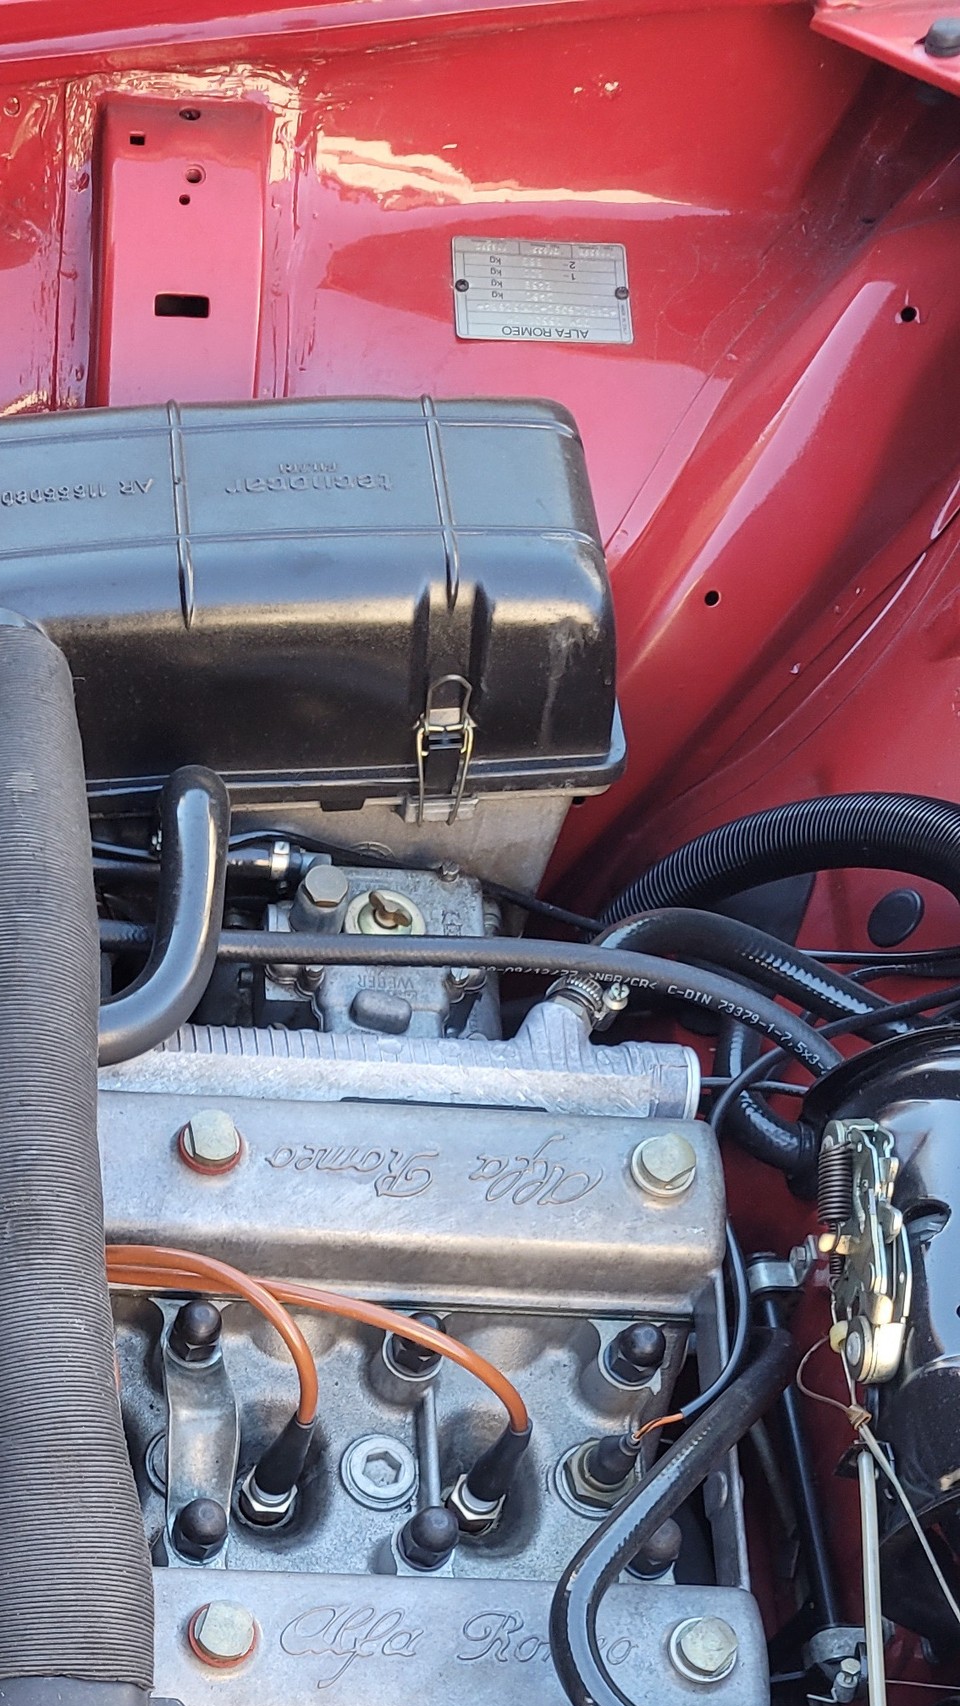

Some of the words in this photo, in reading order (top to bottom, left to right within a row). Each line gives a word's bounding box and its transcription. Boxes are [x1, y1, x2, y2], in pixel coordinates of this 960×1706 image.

[502, 325, 552, 337] ROMEO
[555, 329, 589, 339] ALFA
[119, 478, 153, 495] AR
[667, 985, 713, 1005] C-DIN
[264, 1143, 439, 1197] Romeo
[468, 1134, 604, 1206] Alfa
[280, 1605, 425, 1689] Alfa
